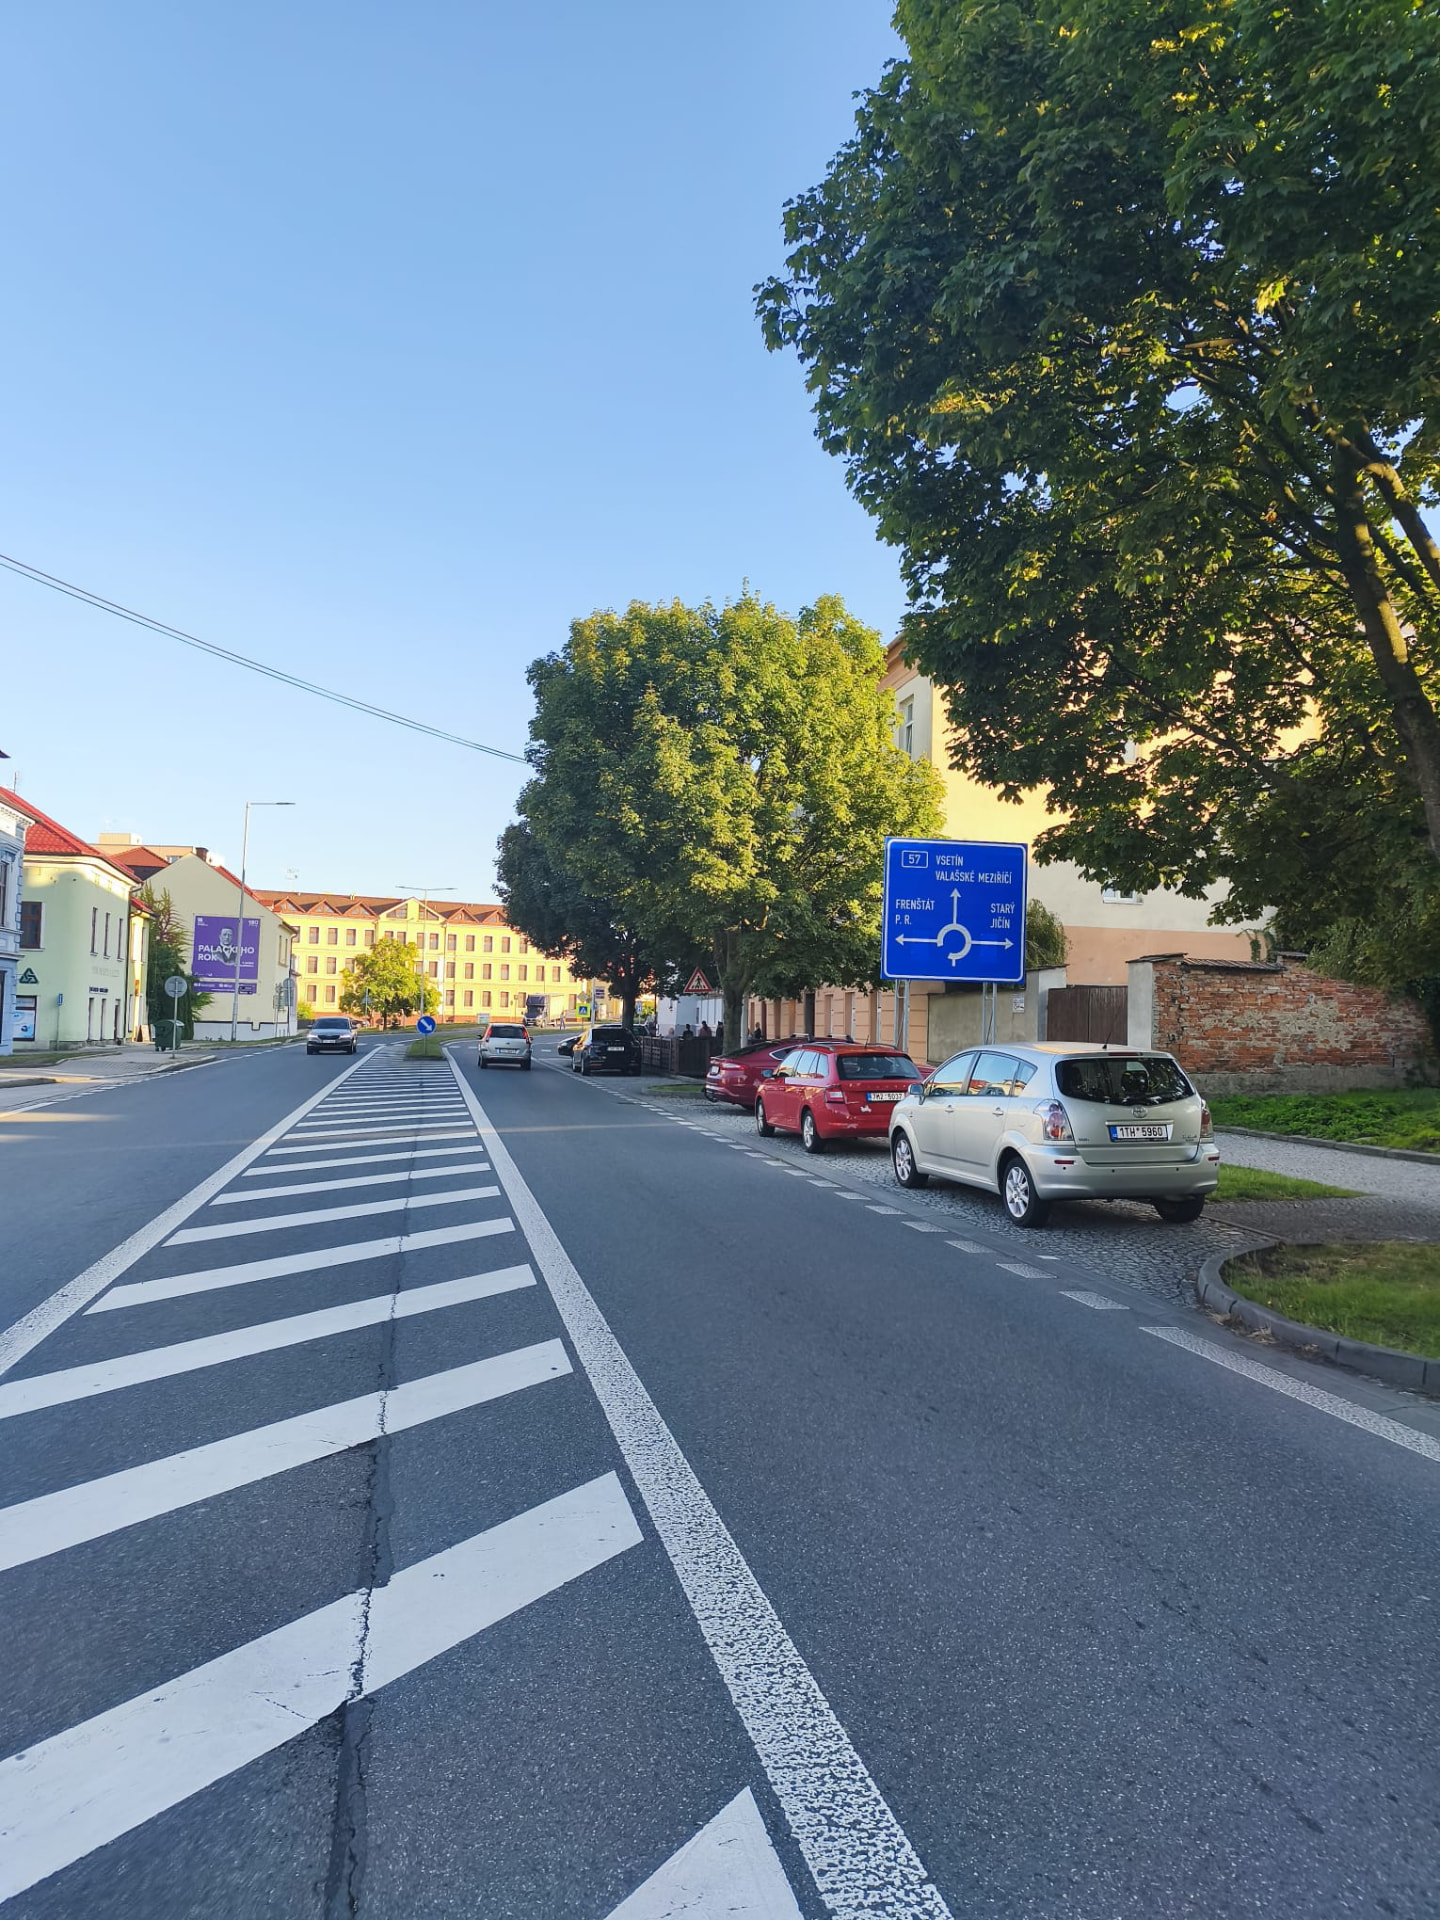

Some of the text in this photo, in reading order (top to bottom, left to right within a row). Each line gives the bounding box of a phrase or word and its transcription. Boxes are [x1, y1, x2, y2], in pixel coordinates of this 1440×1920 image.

[909, 855, 920, 864] 57
[936, 855, 963, 866] VSETÍN
[936, 870, 1012, 884] VALAŠSKÉ MEZIŘÍČÍ
[896, 898, 935, 910] FRENŠTÁT
[991, 902, 1015, 913] STARÝ
[896, 915, 911, 924] P. R.
[990, 918, 1010, 928] JIČÍN
[198, 953, 217, 961] ROK
[1120, 1127, 1163, 1137] 1TH 5960
